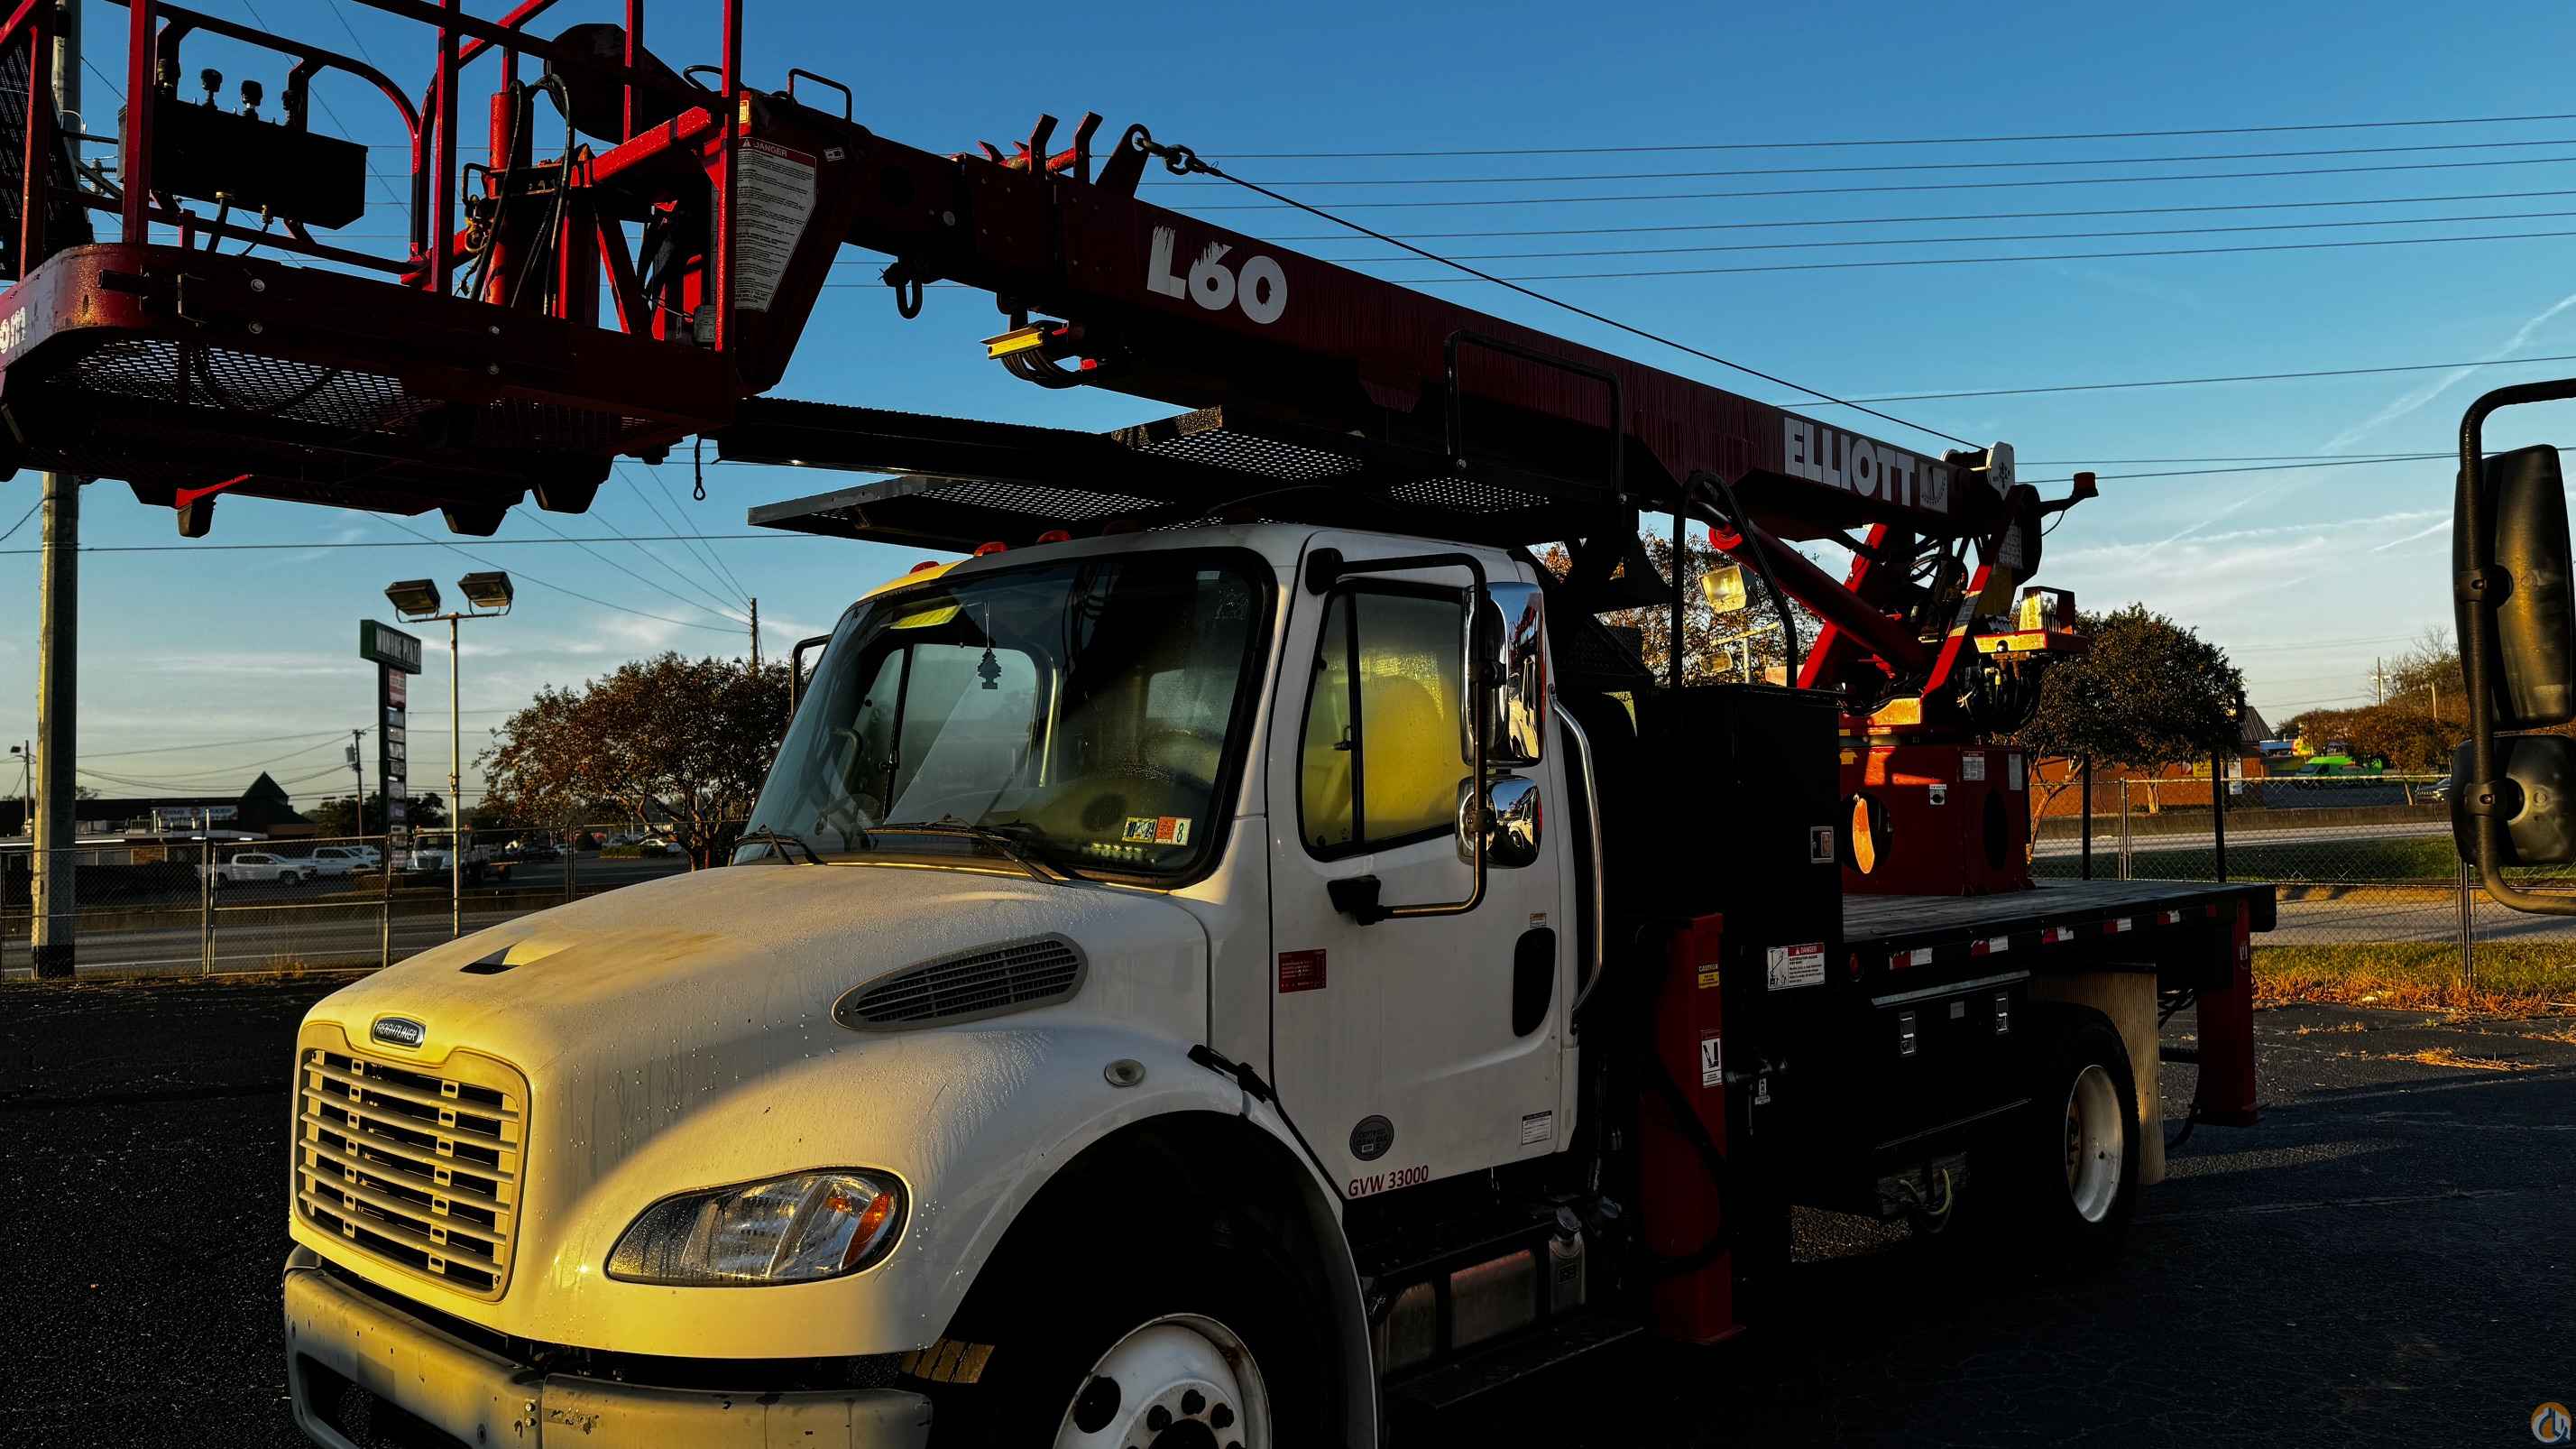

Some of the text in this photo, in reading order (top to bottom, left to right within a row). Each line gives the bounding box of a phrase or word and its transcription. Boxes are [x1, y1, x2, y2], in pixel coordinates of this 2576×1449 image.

[1147, 225, 1288, 325] L60
[1784, 417, 1916, 507] ELLIOTT
[1176, 822, 1184, 844] 8
[1348, 1165, 1429, 1196] GVW 33000
